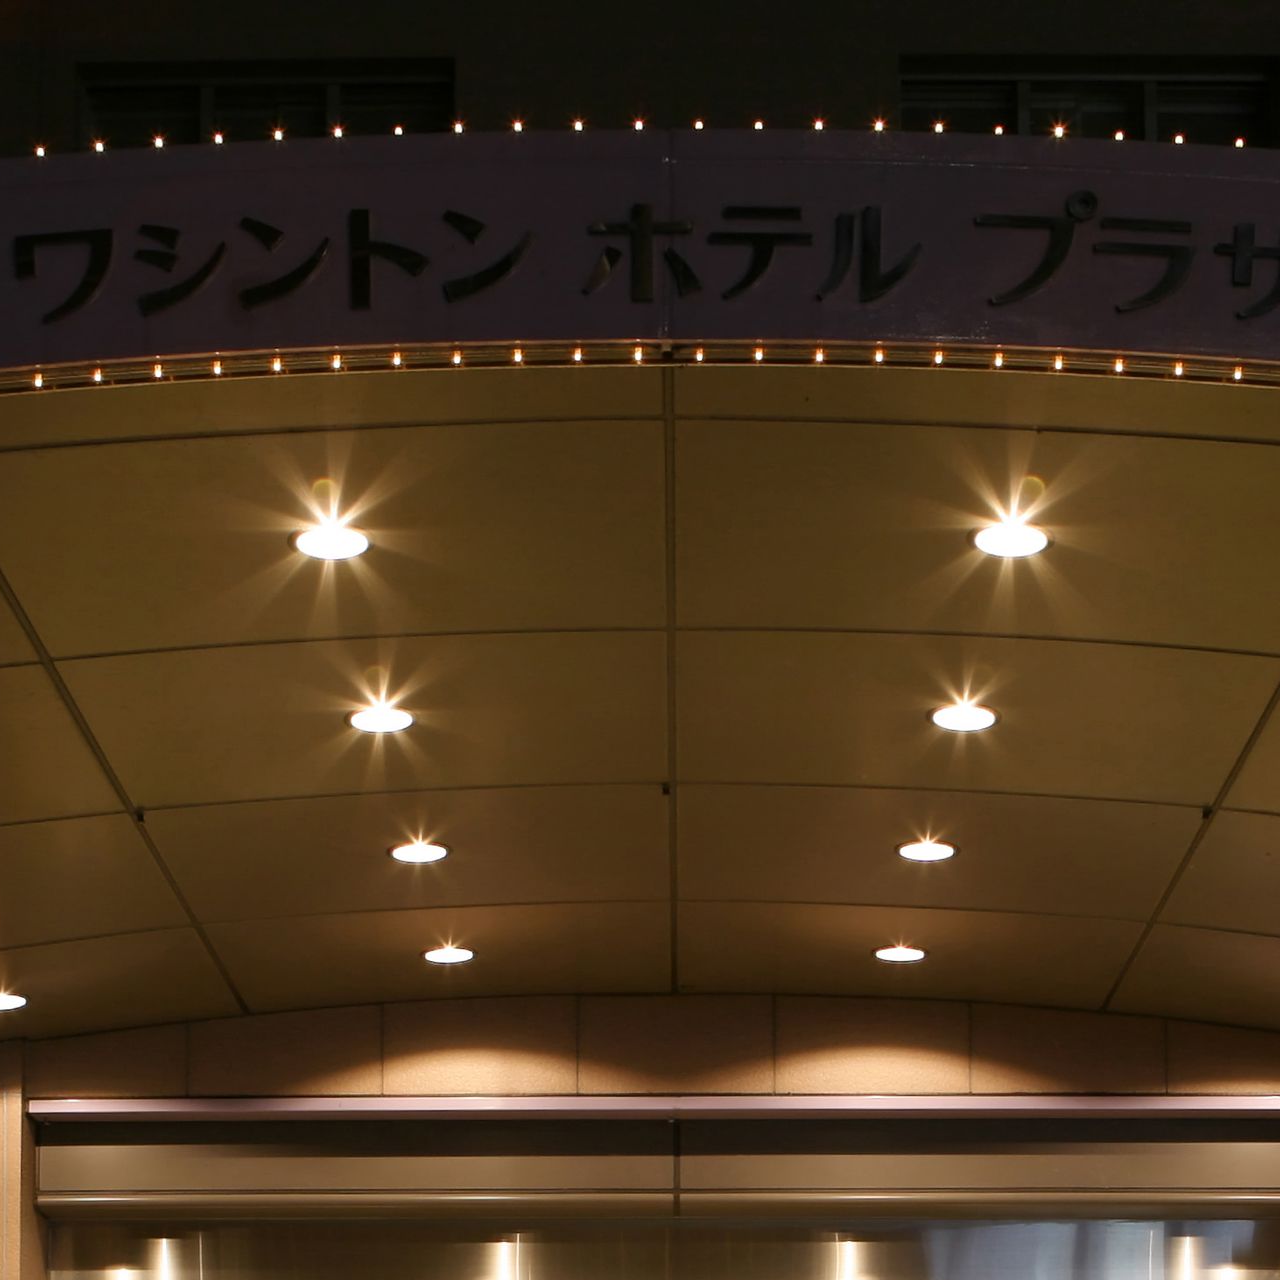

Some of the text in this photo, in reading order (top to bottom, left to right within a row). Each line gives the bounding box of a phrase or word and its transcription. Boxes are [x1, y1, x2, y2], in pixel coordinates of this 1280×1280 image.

[11, 206, 535, 323] ワシントン
[581, 202, 923, 306] ホテル
